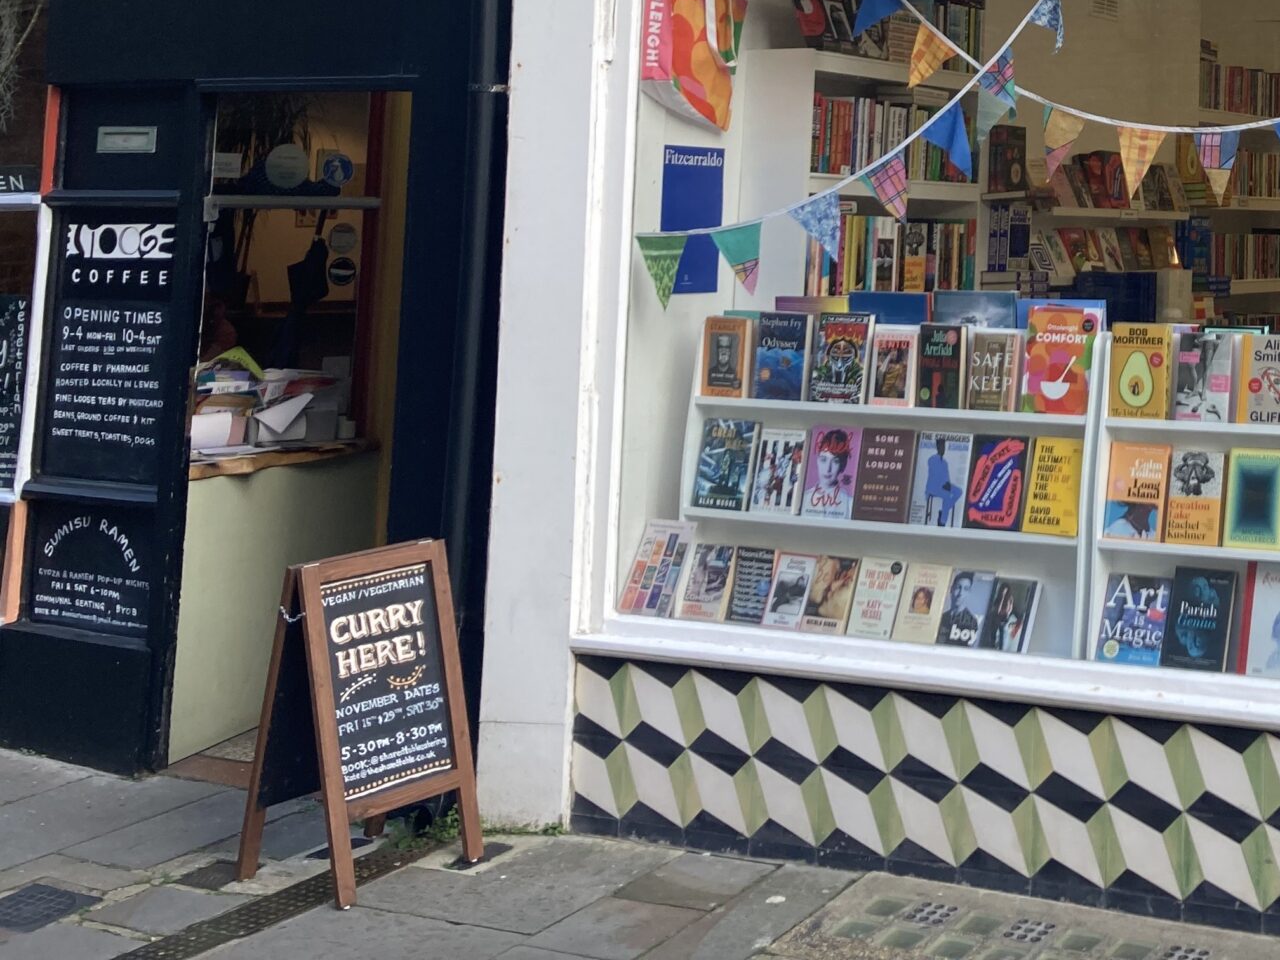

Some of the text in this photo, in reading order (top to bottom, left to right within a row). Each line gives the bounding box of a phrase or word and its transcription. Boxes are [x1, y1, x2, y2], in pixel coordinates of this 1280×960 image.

[664, 148, 723, 168] Fitzcarraldo
[72, 268, 168, 286] COFFEE
[64, 307, 162, 324] OPENING TIMES
[761, 317, 802, 330] Stephen Fry
[62, 326, 83, 340] 9-4
[86, 332, 116, 341] MON-FRI
[146, 335, 162, 345] SAT
[1036, 332, 1088, 344] COMFORT
[1129, 328, 1148, 337] BOB
[762, 336, 798, 349] Odyssey
[1113, 336, 1163, 346] MORTIMER
[1264, 340, 1280, 350] Ali
[972, 351, 1013, 367] SAFE
[60, 362, 150, 373] COFFEE BY PHARMACIE
[55, 378, 159, 389] ROASTED LOCALLY IN LEWES
[969, 376, 1013, 392] KEEP
[55, 393, 72, 402] FINE
[74, 394, 96, 404] LOOSE
[98, 396, 116, 405] TEAS
[118, 397, 127, 406] BY
[104, 414, 130, 423] COFFEE
[52, 428, 73, 436] SWEET
[922, 433, 933, 441] THE
[875, 435, 900, 444] SOME
[867, 447, 904, 457] MEN IN
[1041, 445, 1055, 454] THE
[866, 460, 903, 470] LONDON
[1039, 455, 1072, 464] ULTIMATE
[1035, 482, 1048, 491] THE
[1133, 478, 1160, 490] Long
[811, 483, 842, 508] Girl
[1127, 488, 1160, 499] Island
[1031, 506, 1051, 515] DAVID
[1169, 500, 1210, 511] Creation
[1168, 511, 1191, 521] Lake
[1168, 520, 1200, 530] Rachel
[1167, 530, 1206, 541] Kushner
[44, 516, 140, 572] SUMISU RAMEN
[51, 581, 63, 590] FRI
[74, 584, 88, 593] SAT
[1107, 575, 1168, 611] Art
[116, 604, 137, 616] BYOB
[1181, 601, 1217, 618] Pariah
[330, 599, 424, 644] CURRY
[1134, 611, 1145, 626] is
[1178, 615, 1216, 630] Genius
[950, 624, 977, 646] boy
[1101, 618, 1162, 647] Magic
[335, 631, 426, 678] HERE!
[335, 683, 440, 719] NOVEMBER DATES
[338, 720, 359, 736] FRI
[406, 701, 425, 717] SAT
